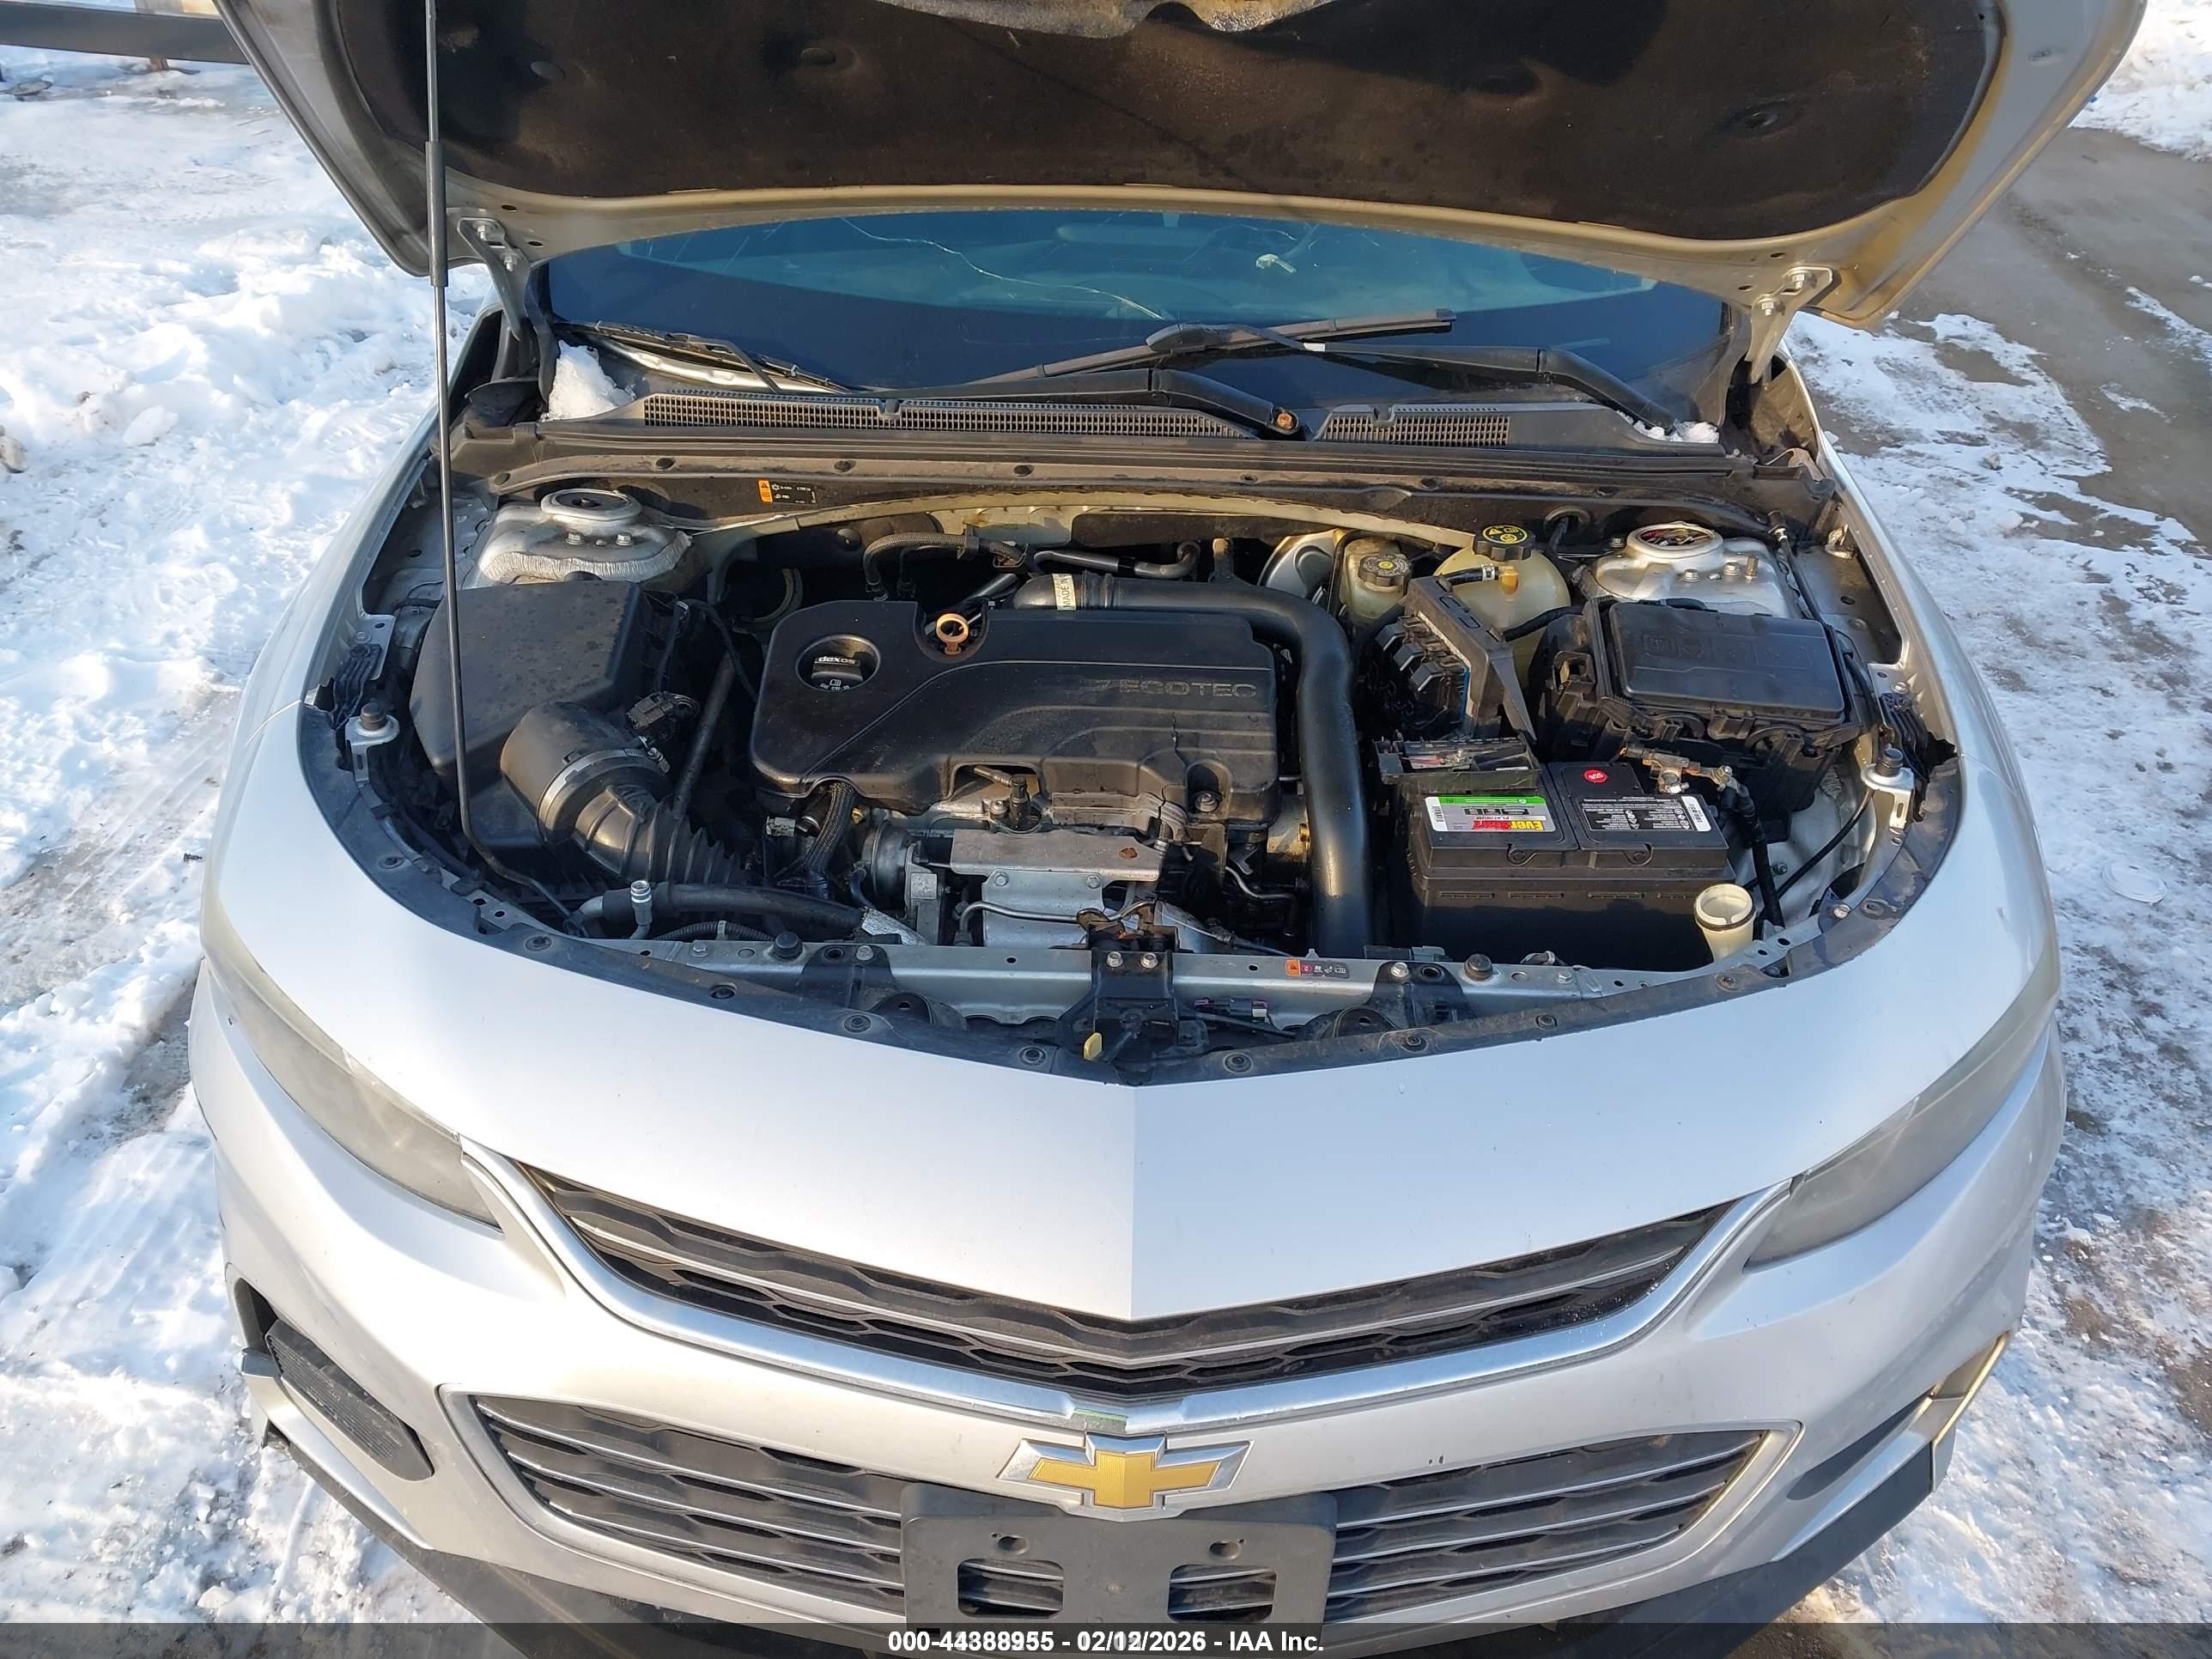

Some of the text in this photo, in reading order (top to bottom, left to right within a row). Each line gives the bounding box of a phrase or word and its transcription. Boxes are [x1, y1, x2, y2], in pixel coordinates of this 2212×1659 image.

[1061, 586, 1073, 608] MADE
[817, 656, 855, 665] dexos
[1119, 678, 1256, 697] ECOTEC
[1472, 819, 1544, 830] EverStart
